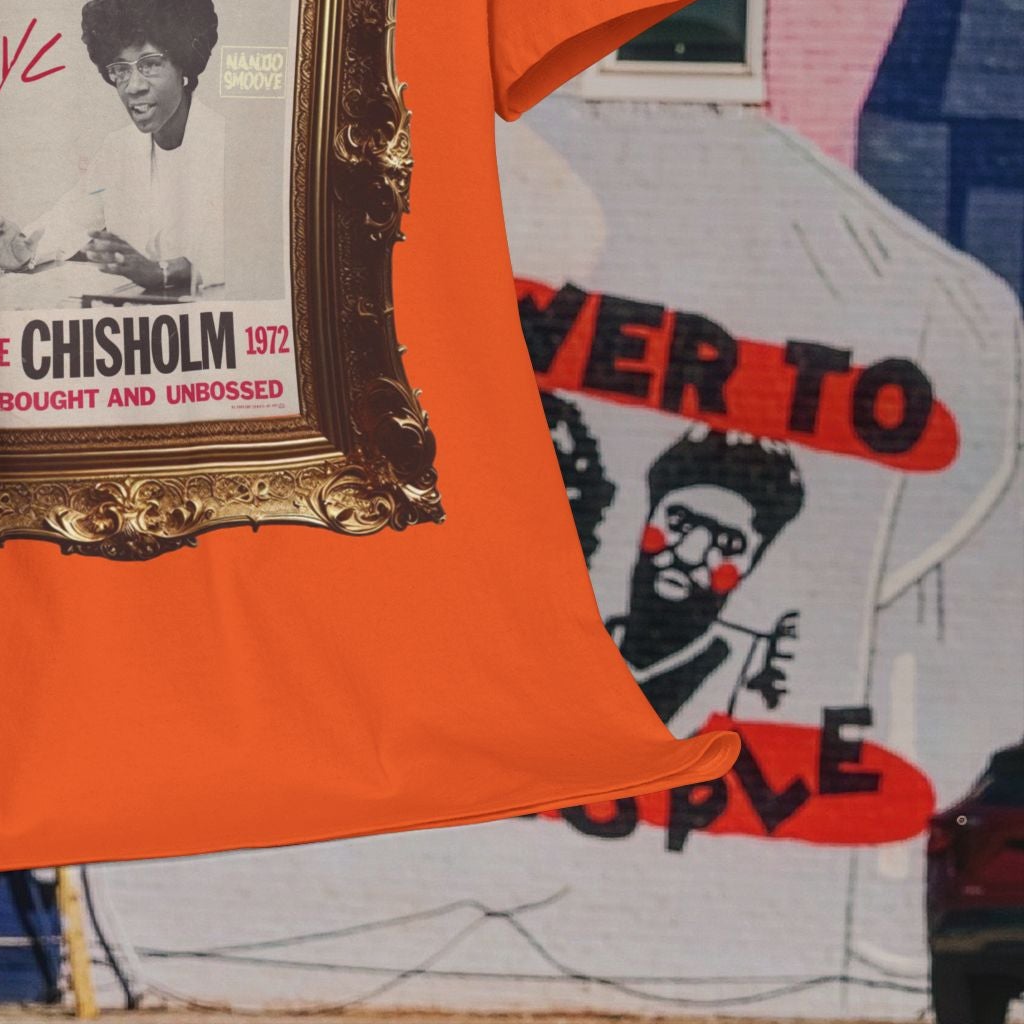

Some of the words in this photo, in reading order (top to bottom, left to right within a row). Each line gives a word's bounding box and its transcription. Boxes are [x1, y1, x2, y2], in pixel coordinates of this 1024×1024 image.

[226, 52, 284, 72] NANDO
[223, 70, 283, 91] SMOOVE
[21, 311, 236, 380] CHISHOLM
[245, 325, 290, 355] 1972
[107, 386, 156, 408] AND
[166, 379, 284, 404] UNBOSSED
[785, 339, 934, 454] TO
